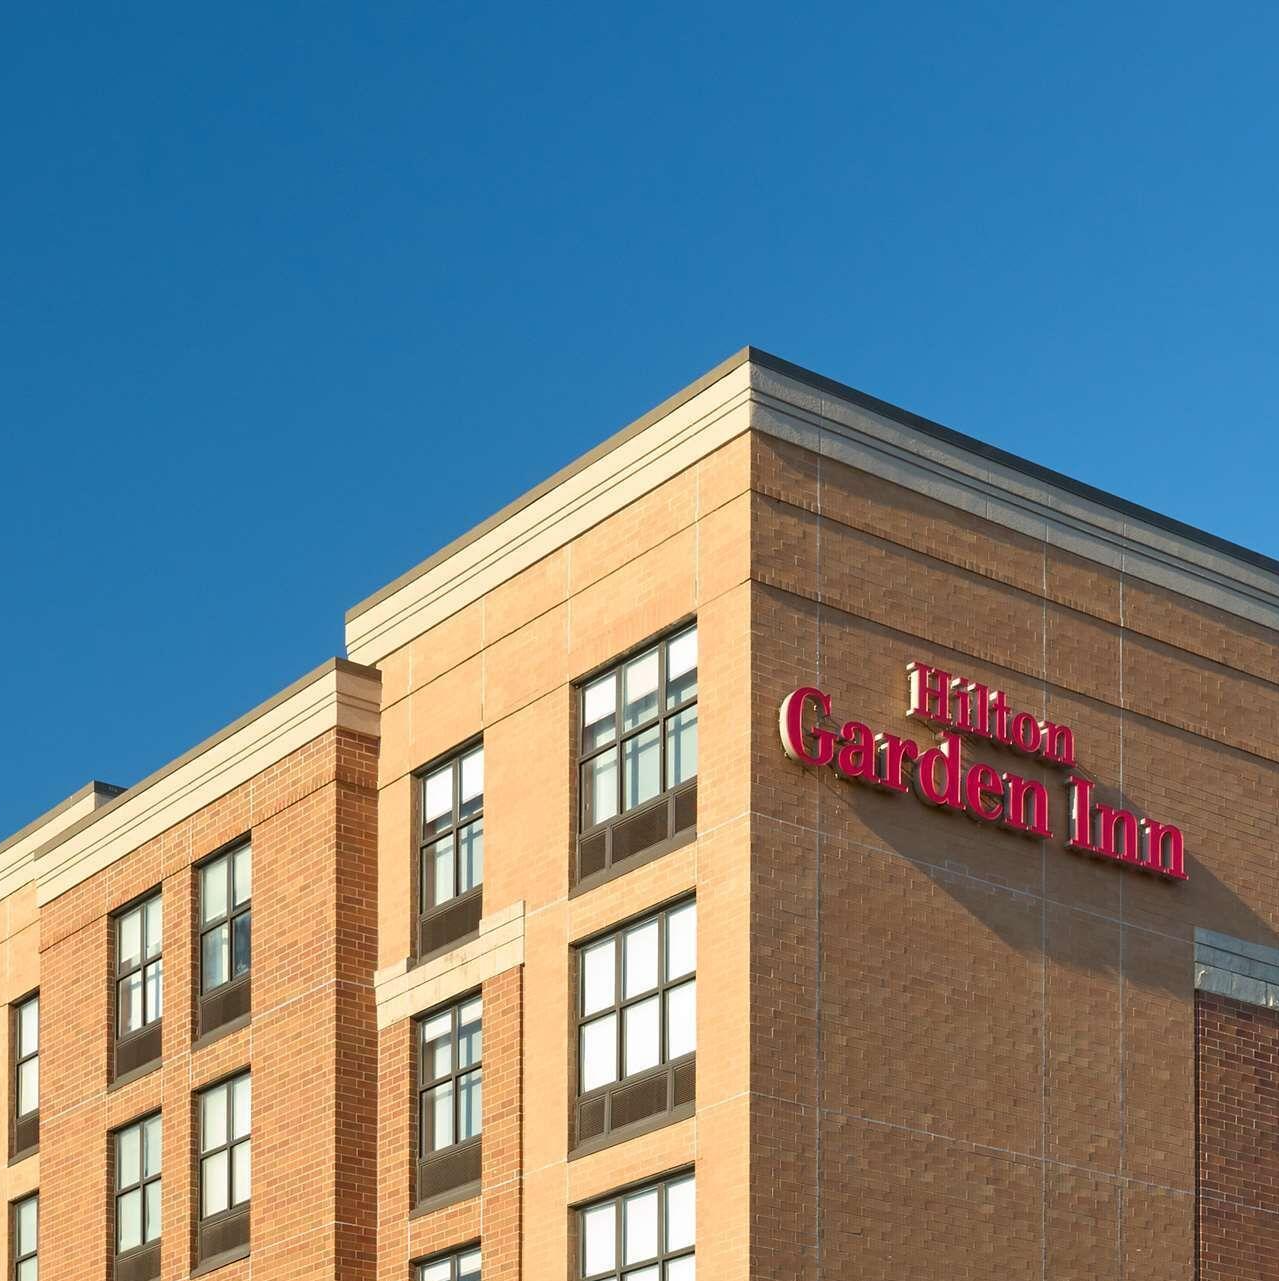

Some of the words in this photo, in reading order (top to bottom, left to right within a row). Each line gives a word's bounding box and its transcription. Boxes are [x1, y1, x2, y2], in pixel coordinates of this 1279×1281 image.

[779, 687, 1053, 839] Garden
[1064, 775, 1188, 880] Inn
[906, 662, 1076, 767] Hilton
